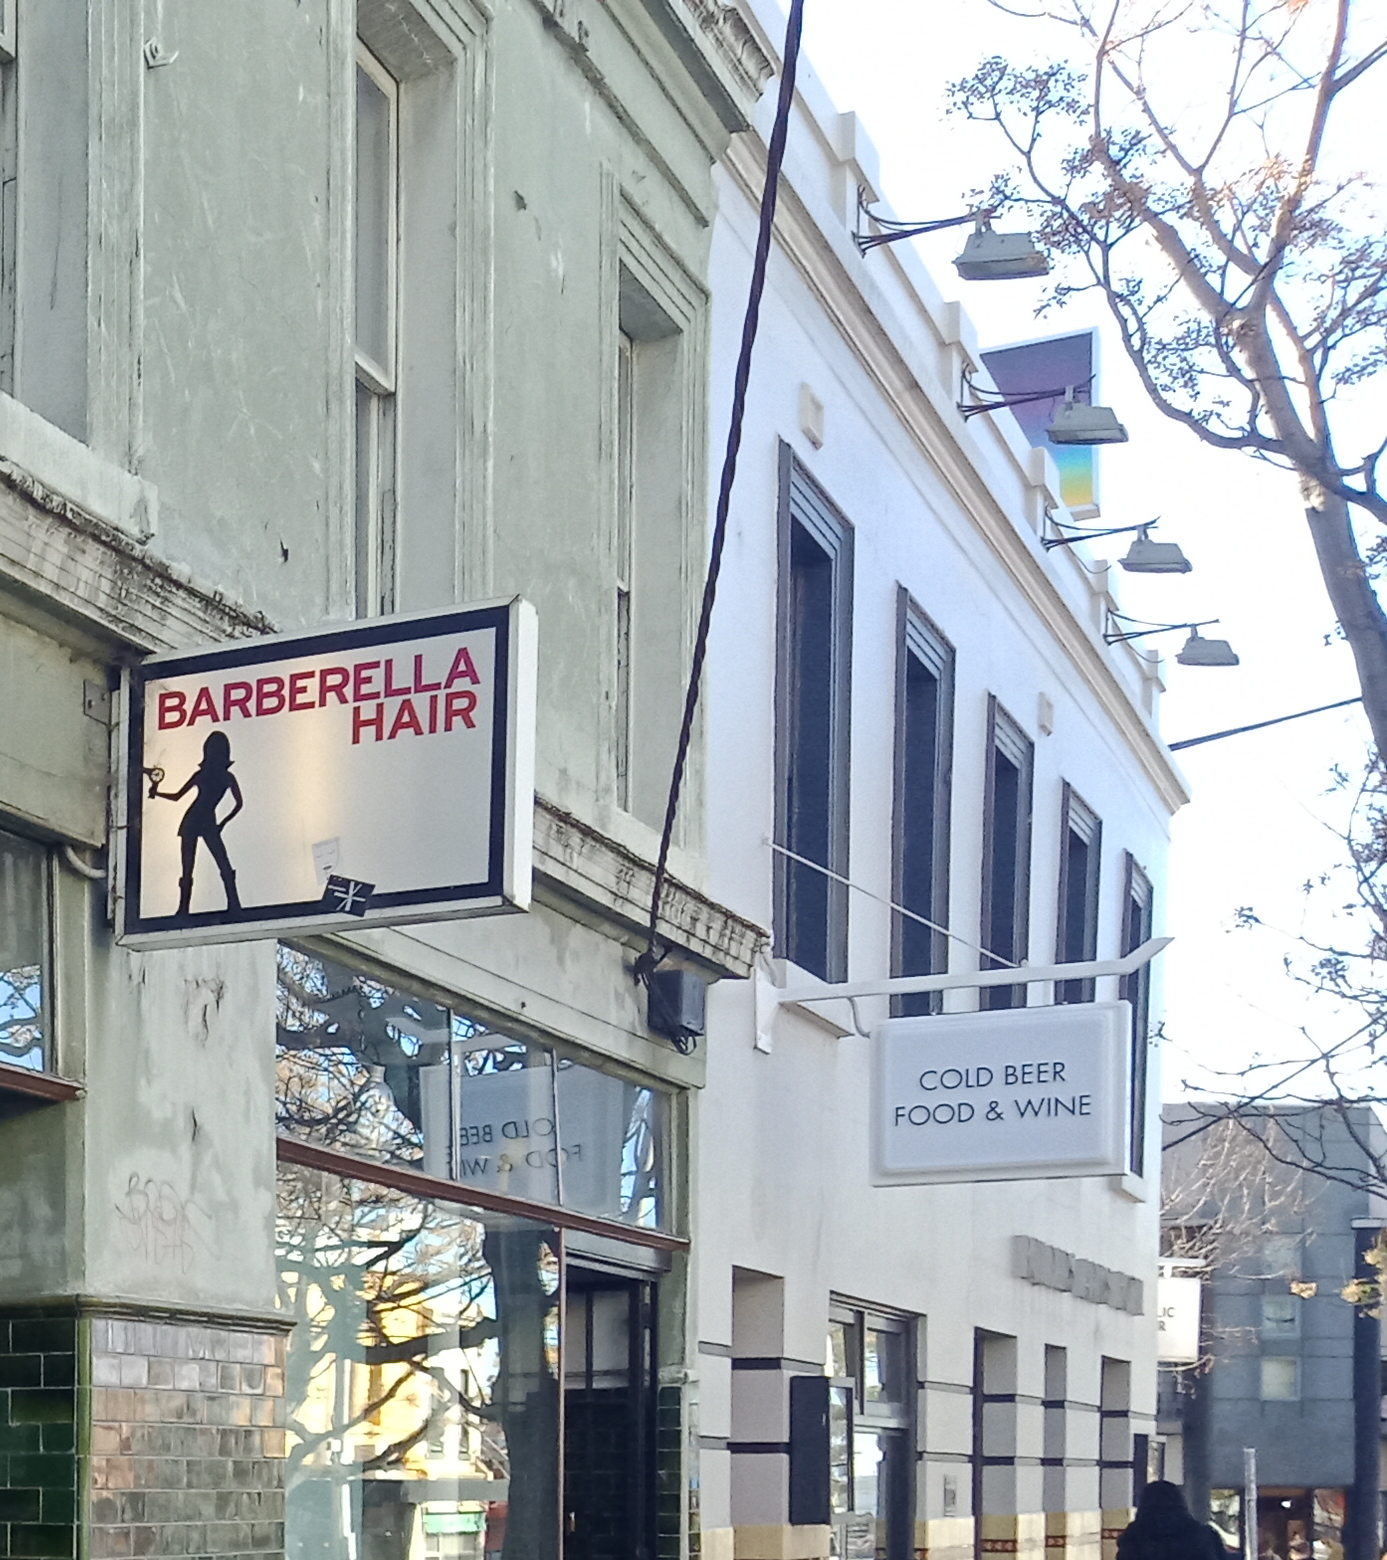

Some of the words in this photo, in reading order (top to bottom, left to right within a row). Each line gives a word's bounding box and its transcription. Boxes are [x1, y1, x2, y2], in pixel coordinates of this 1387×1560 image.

[157, 646, 481, 731] BARBERELLA
[351, 690, 477, 745] HAIR
[919, 1067, 993, 1091] COLD
[1004, 1062, 1066, 1085] BEER
[895, 1102, 975, 1126] FOOD
[986, 1100, 1004, 1121] &
[1014, 1095, 1091, 1118] WINE
